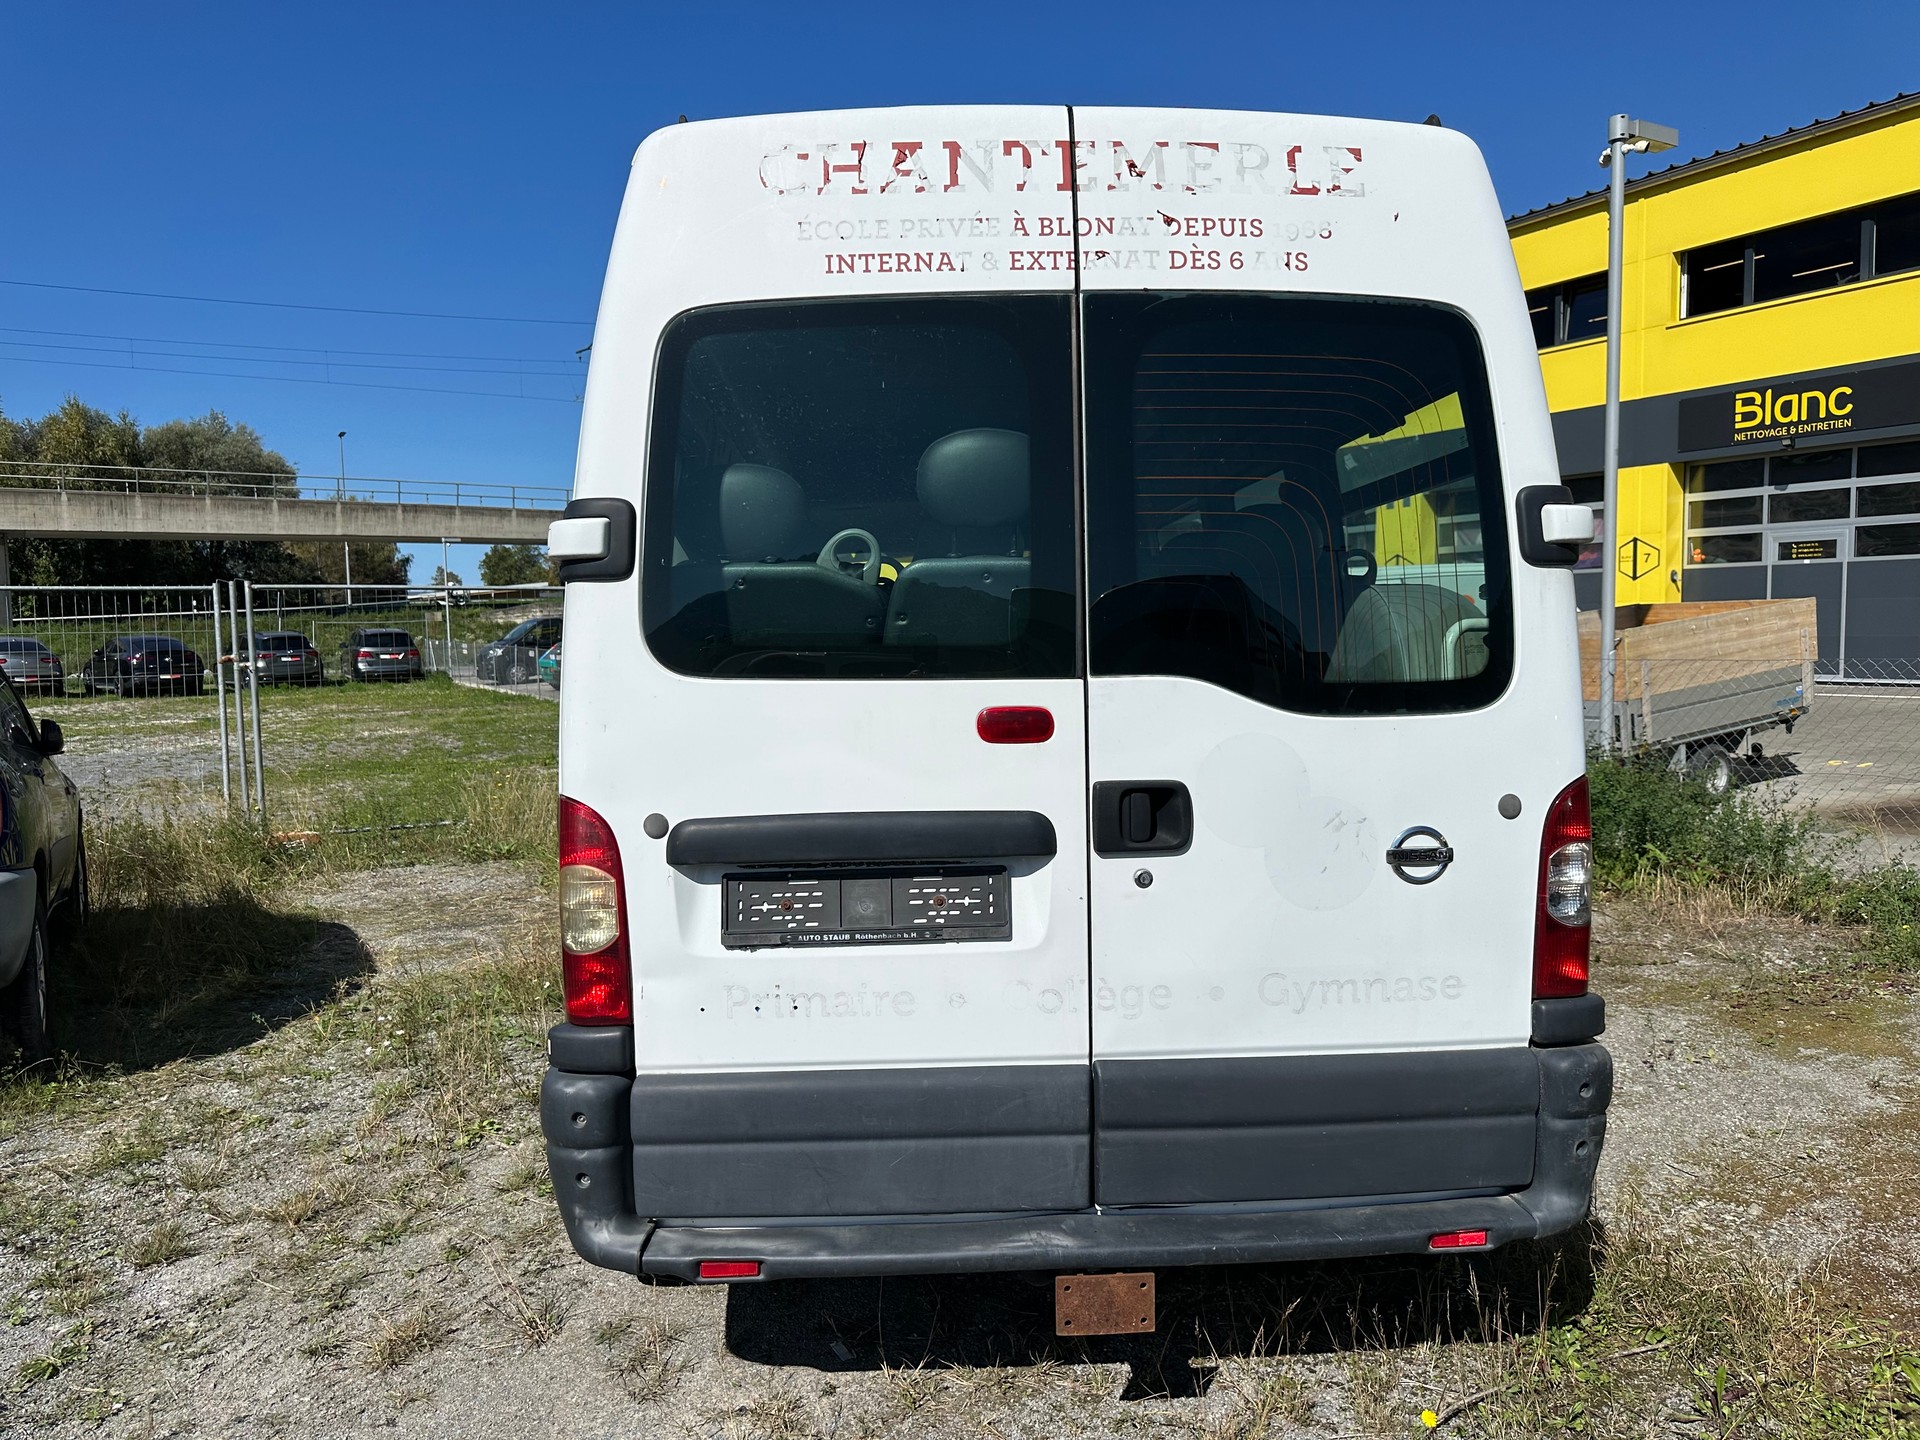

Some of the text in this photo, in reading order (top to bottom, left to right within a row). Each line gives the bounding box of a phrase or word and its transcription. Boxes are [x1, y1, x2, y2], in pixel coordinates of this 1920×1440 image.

[758, 139, 1366, 198] CHANTEMERLE
[797, 213, 889, 241] ÉCOLE
[900, 210, 1000, 240] PRIVÉE
[1009, 210, 1030, 237] À
[1038, 216, 1155, 238] BLONAY
[1163, 216, 1264, 238] DEPUIS
[824, 243, 1309, 274] INTERNAT & EXTERNAT DÈS 6 ANS
[1734, 386, 1854, 429] Blanc
[1734, 418, 1852, 442] NETTOYAGE & ENTRETIEN
[1643, 552, 1651, 563] 7
[1391, 848, 1449, 861] NISSAN
[797, 934, 821, 942] AUTO
[822, 933, 851, 942] STAUB
[724, 982, 916, 1020] Primaire
[1256, 972, 1464, 1015] Gymnase
